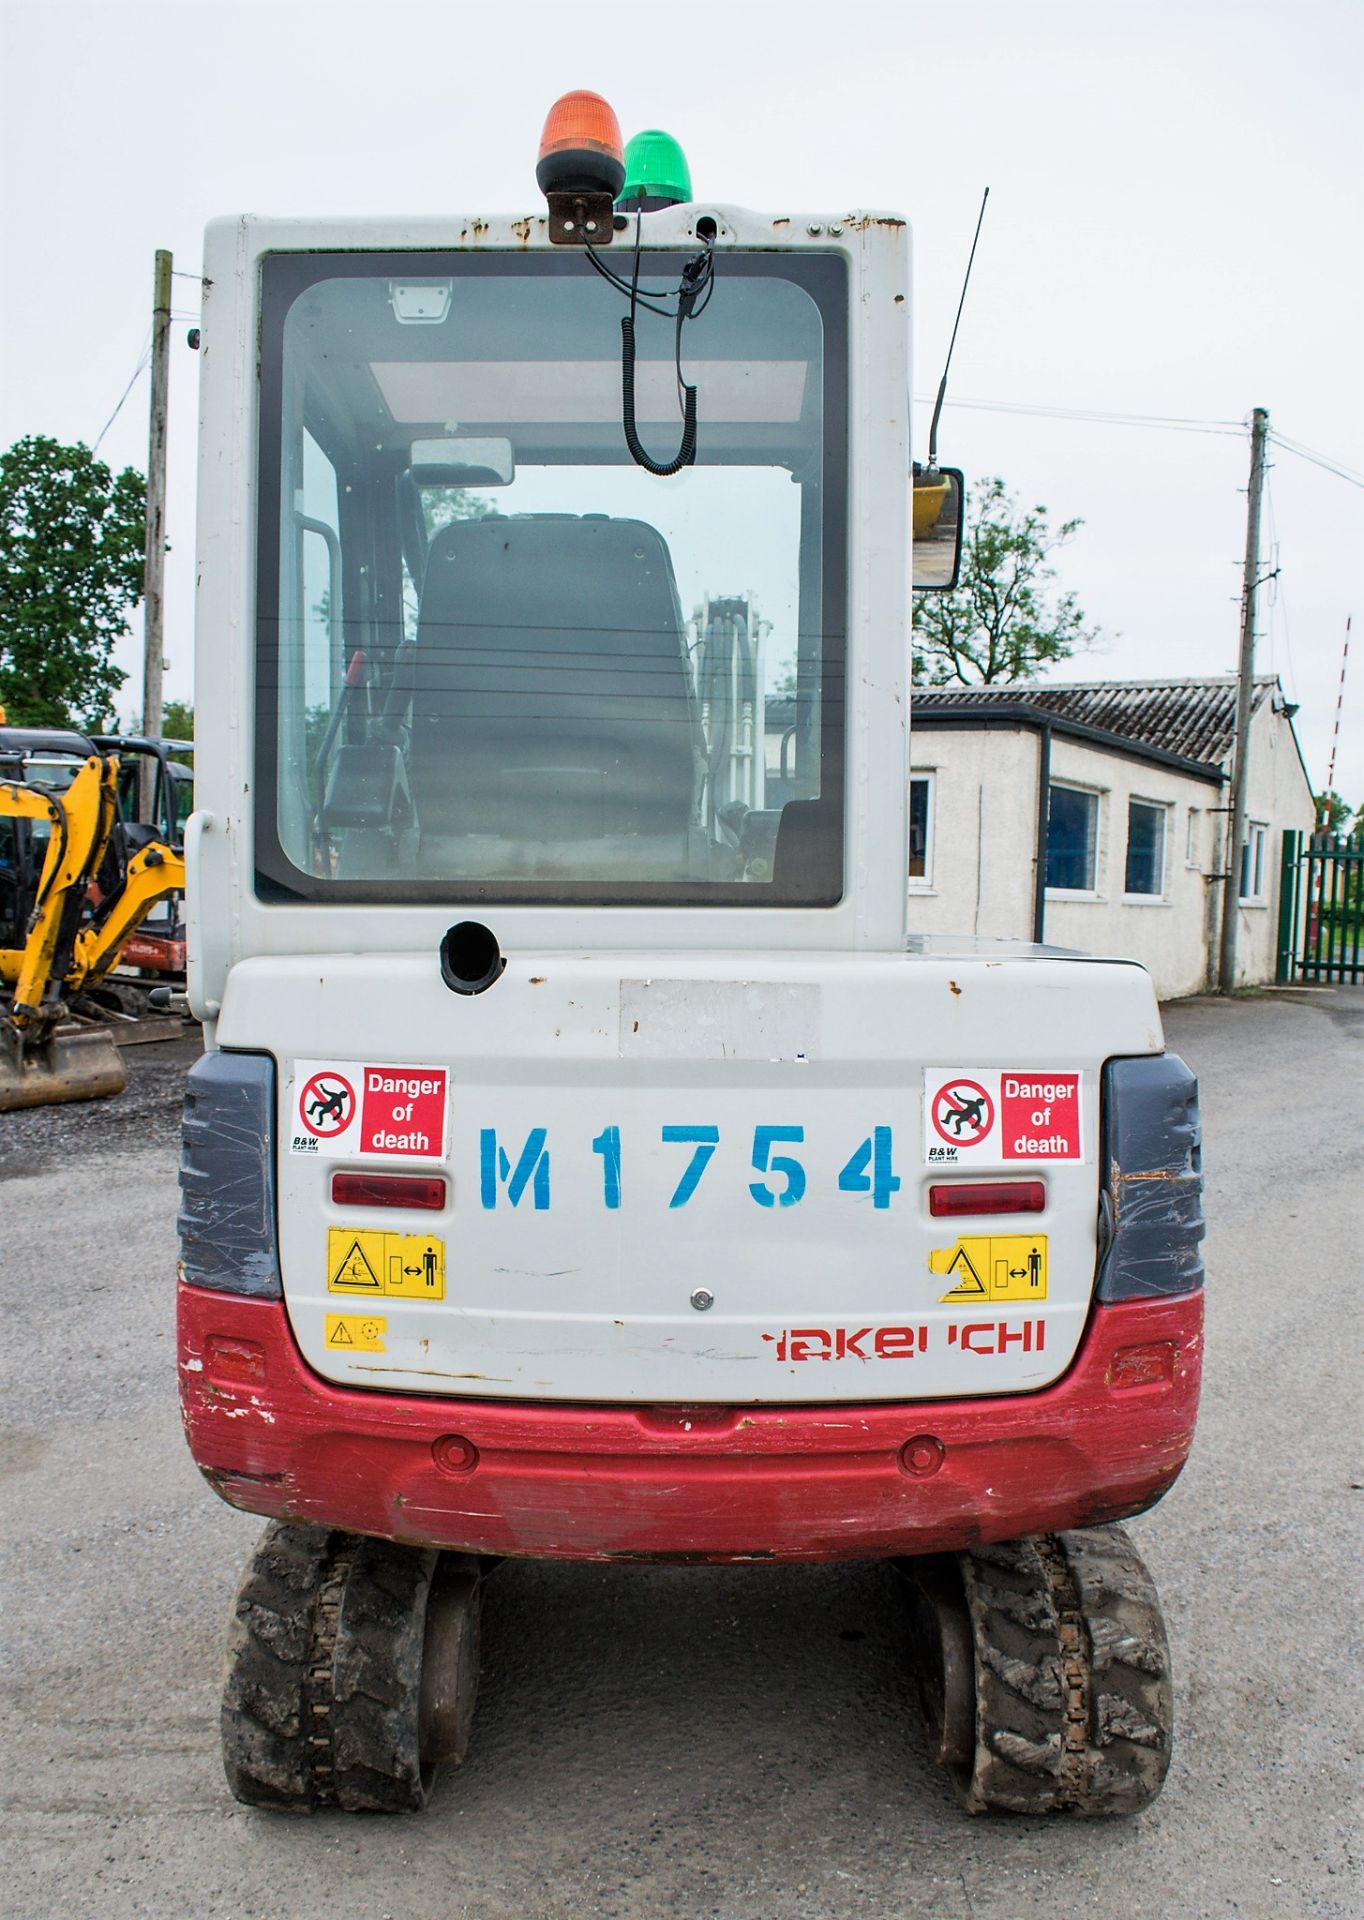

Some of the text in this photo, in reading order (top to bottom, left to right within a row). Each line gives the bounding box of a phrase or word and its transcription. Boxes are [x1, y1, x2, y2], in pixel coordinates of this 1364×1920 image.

[368, 1073, 442, 1099] Danger
[1005, 1079, 1075, 1103] Danger
[391, 1103, 414, 1121] of
[1031, 1107, 1052, 1126] of
[293, 1136, 319, 1146] B&W
[372, 1129, 429, 1150] death
[1013, 1135, 1069, 1154] death
[929, 1147, 958, 1156] B&W
